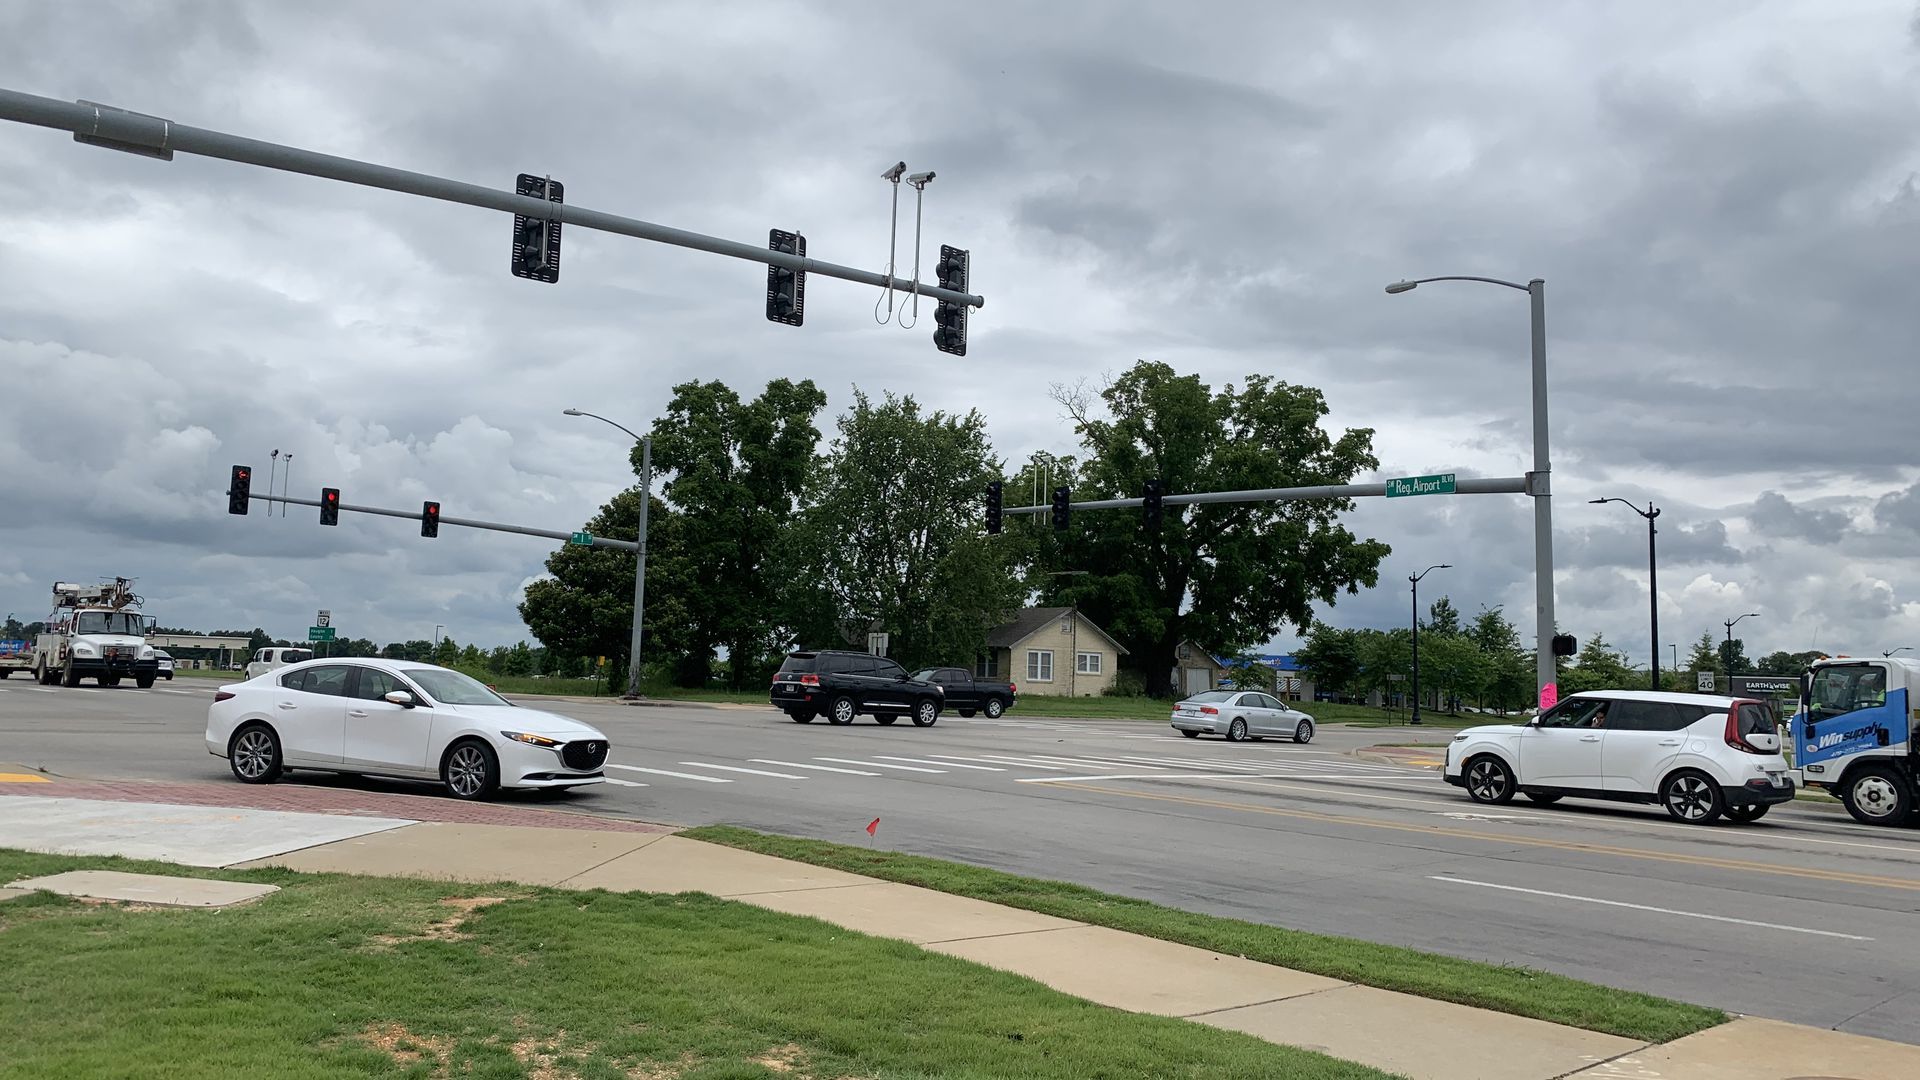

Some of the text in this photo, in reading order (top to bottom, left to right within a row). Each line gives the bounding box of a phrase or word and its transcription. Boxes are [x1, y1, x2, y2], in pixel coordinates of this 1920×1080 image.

[1396, 480, 1412, 494] Reg.
[1413, 478, 1440, 493] Airport
[1441, 475, 1453, 483] BLVD
[1699, 681, 1713, 689] 40
